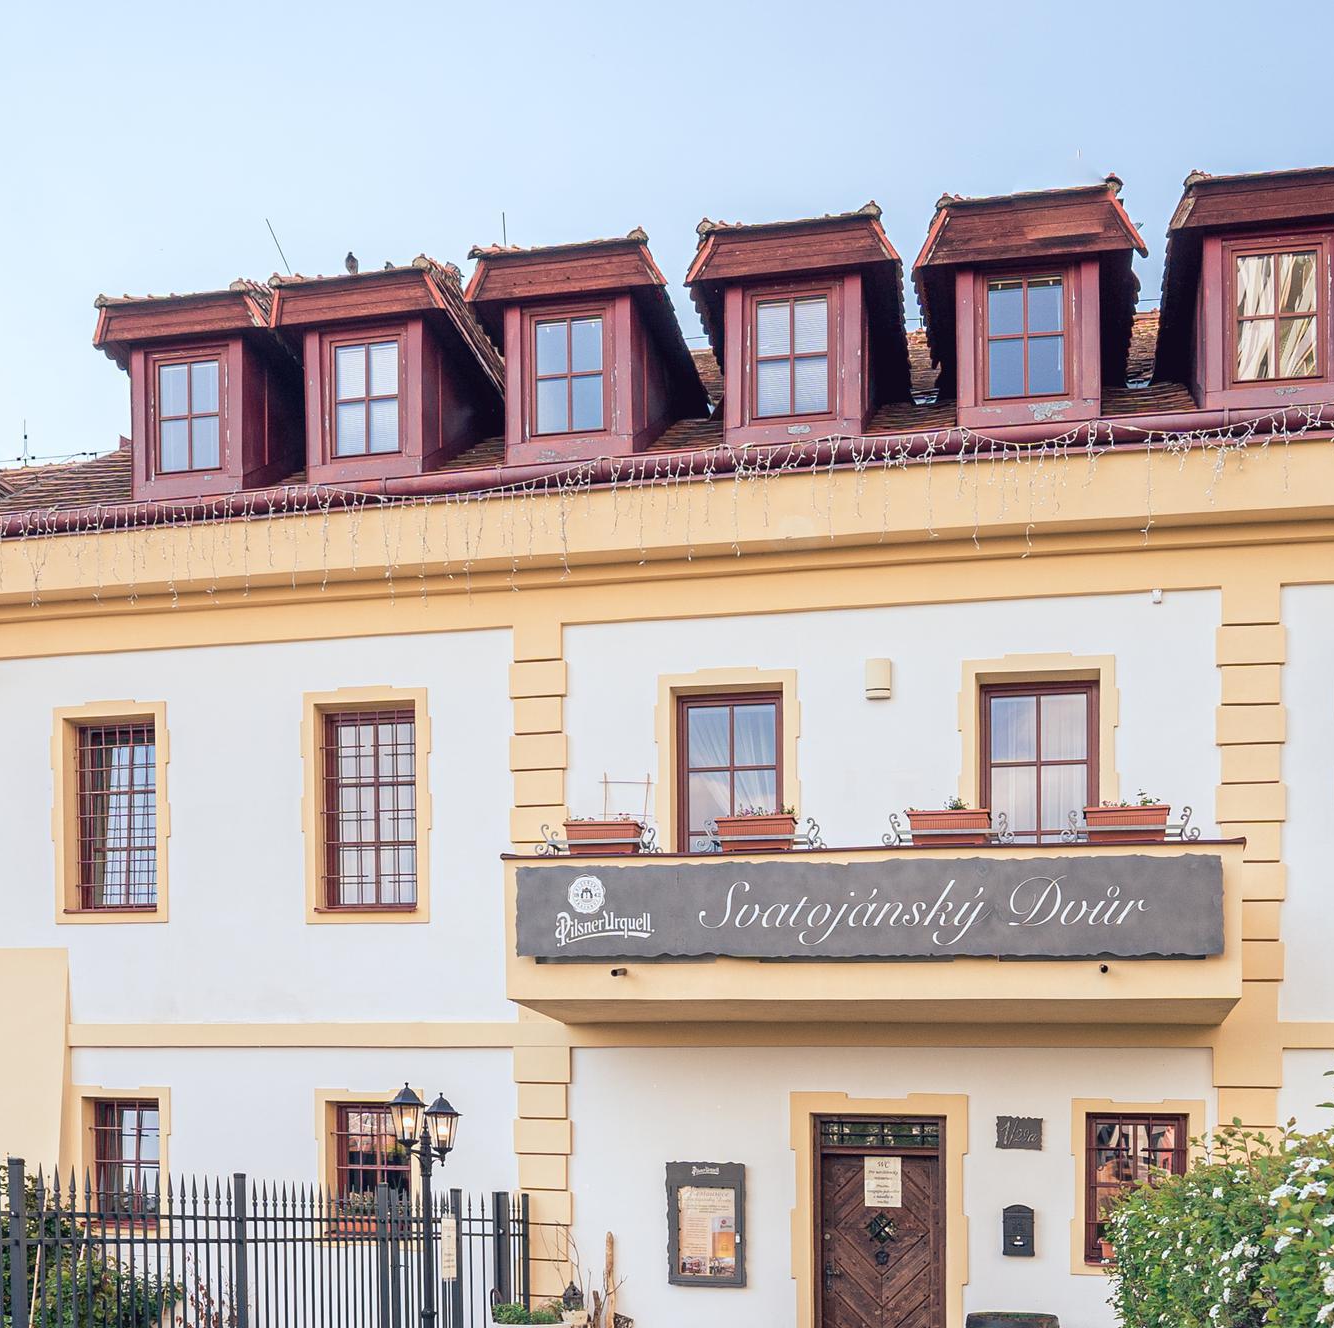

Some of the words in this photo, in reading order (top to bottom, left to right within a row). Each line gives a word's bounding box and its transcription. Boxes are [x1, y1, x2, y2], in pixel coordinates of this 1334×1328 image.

[555, 911, 604, 947] Pilsner
[698, 879, 990, 946] Svatojánský
[1008, 874, 1151, 928] Dvůr
